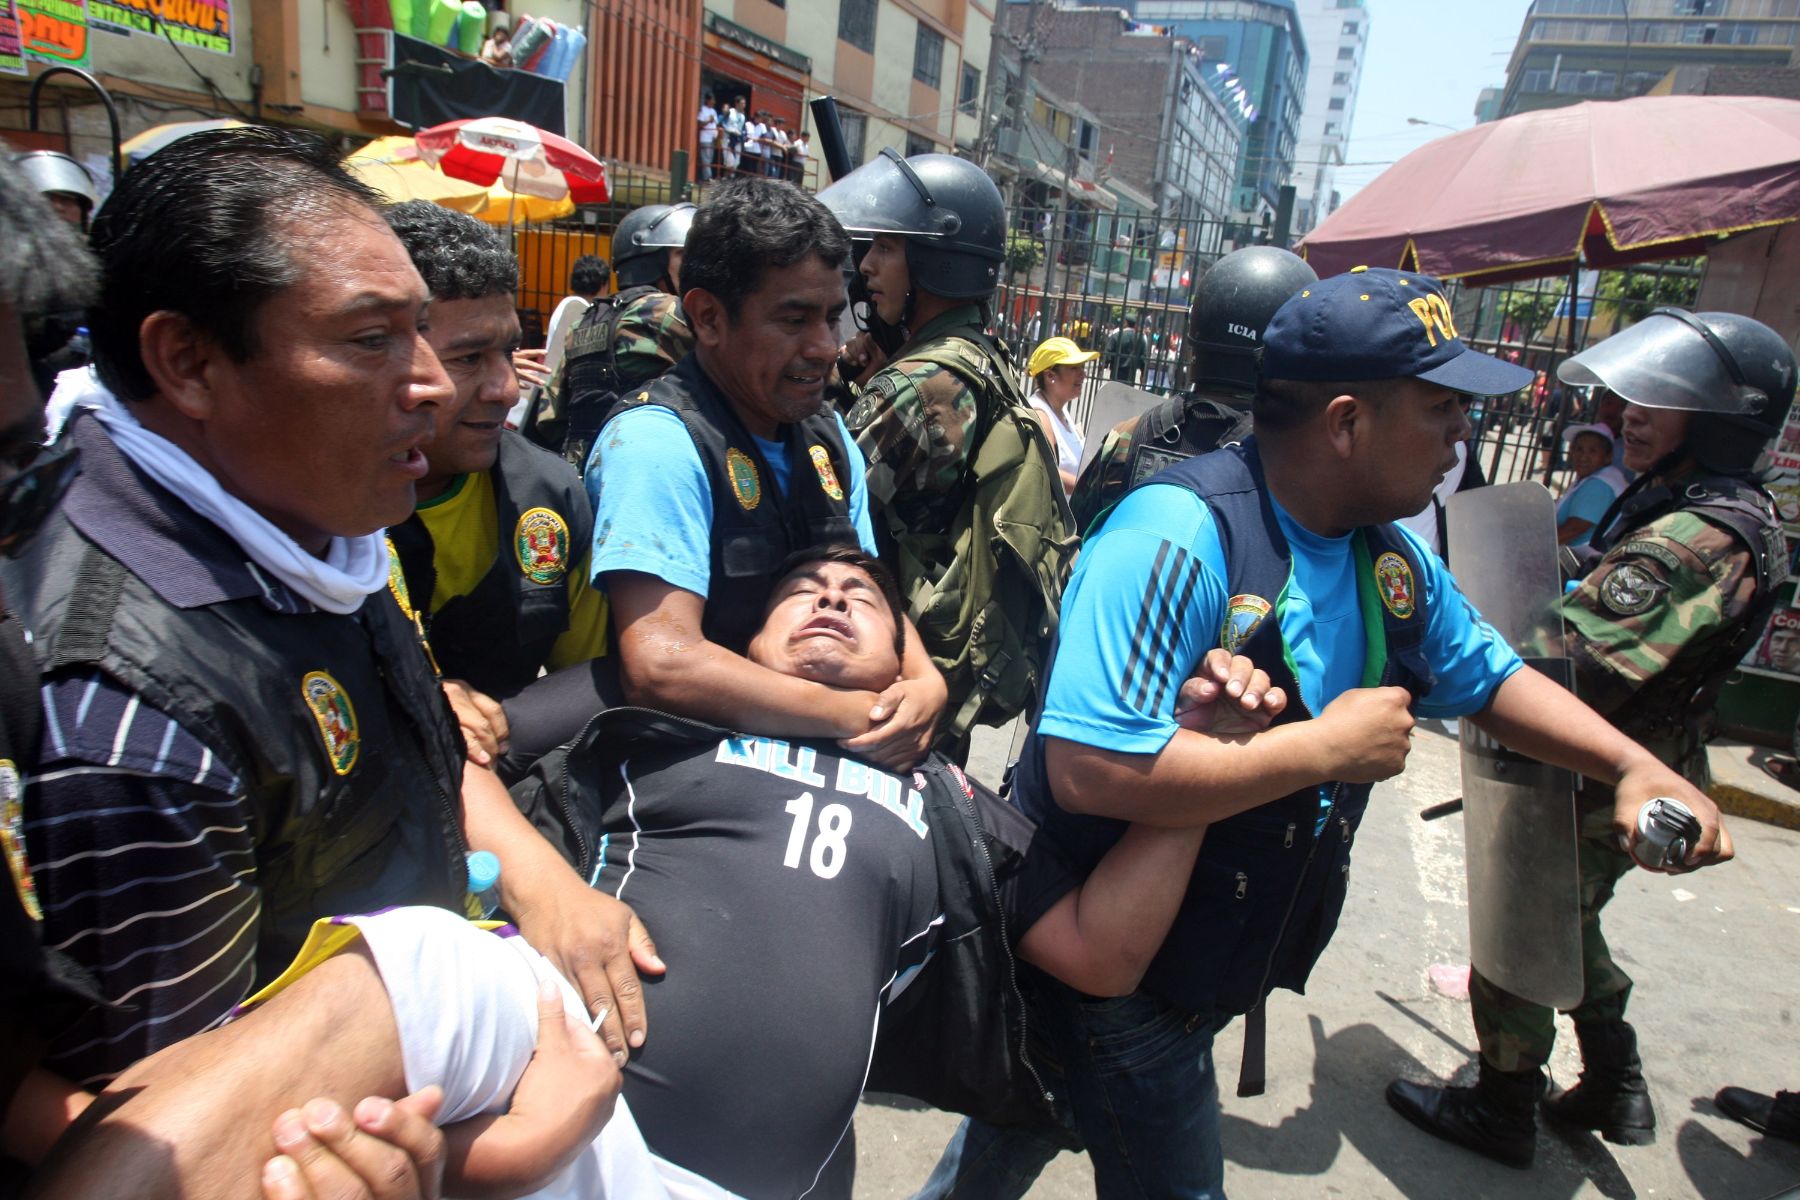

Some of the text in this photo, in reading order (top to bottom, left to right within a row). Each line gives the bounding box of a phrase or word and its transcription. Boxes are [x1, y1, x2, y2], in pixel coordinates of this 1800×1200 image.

[715, 735, 929, 840] KILL BILL
[783, 791, 852, 879] 18
